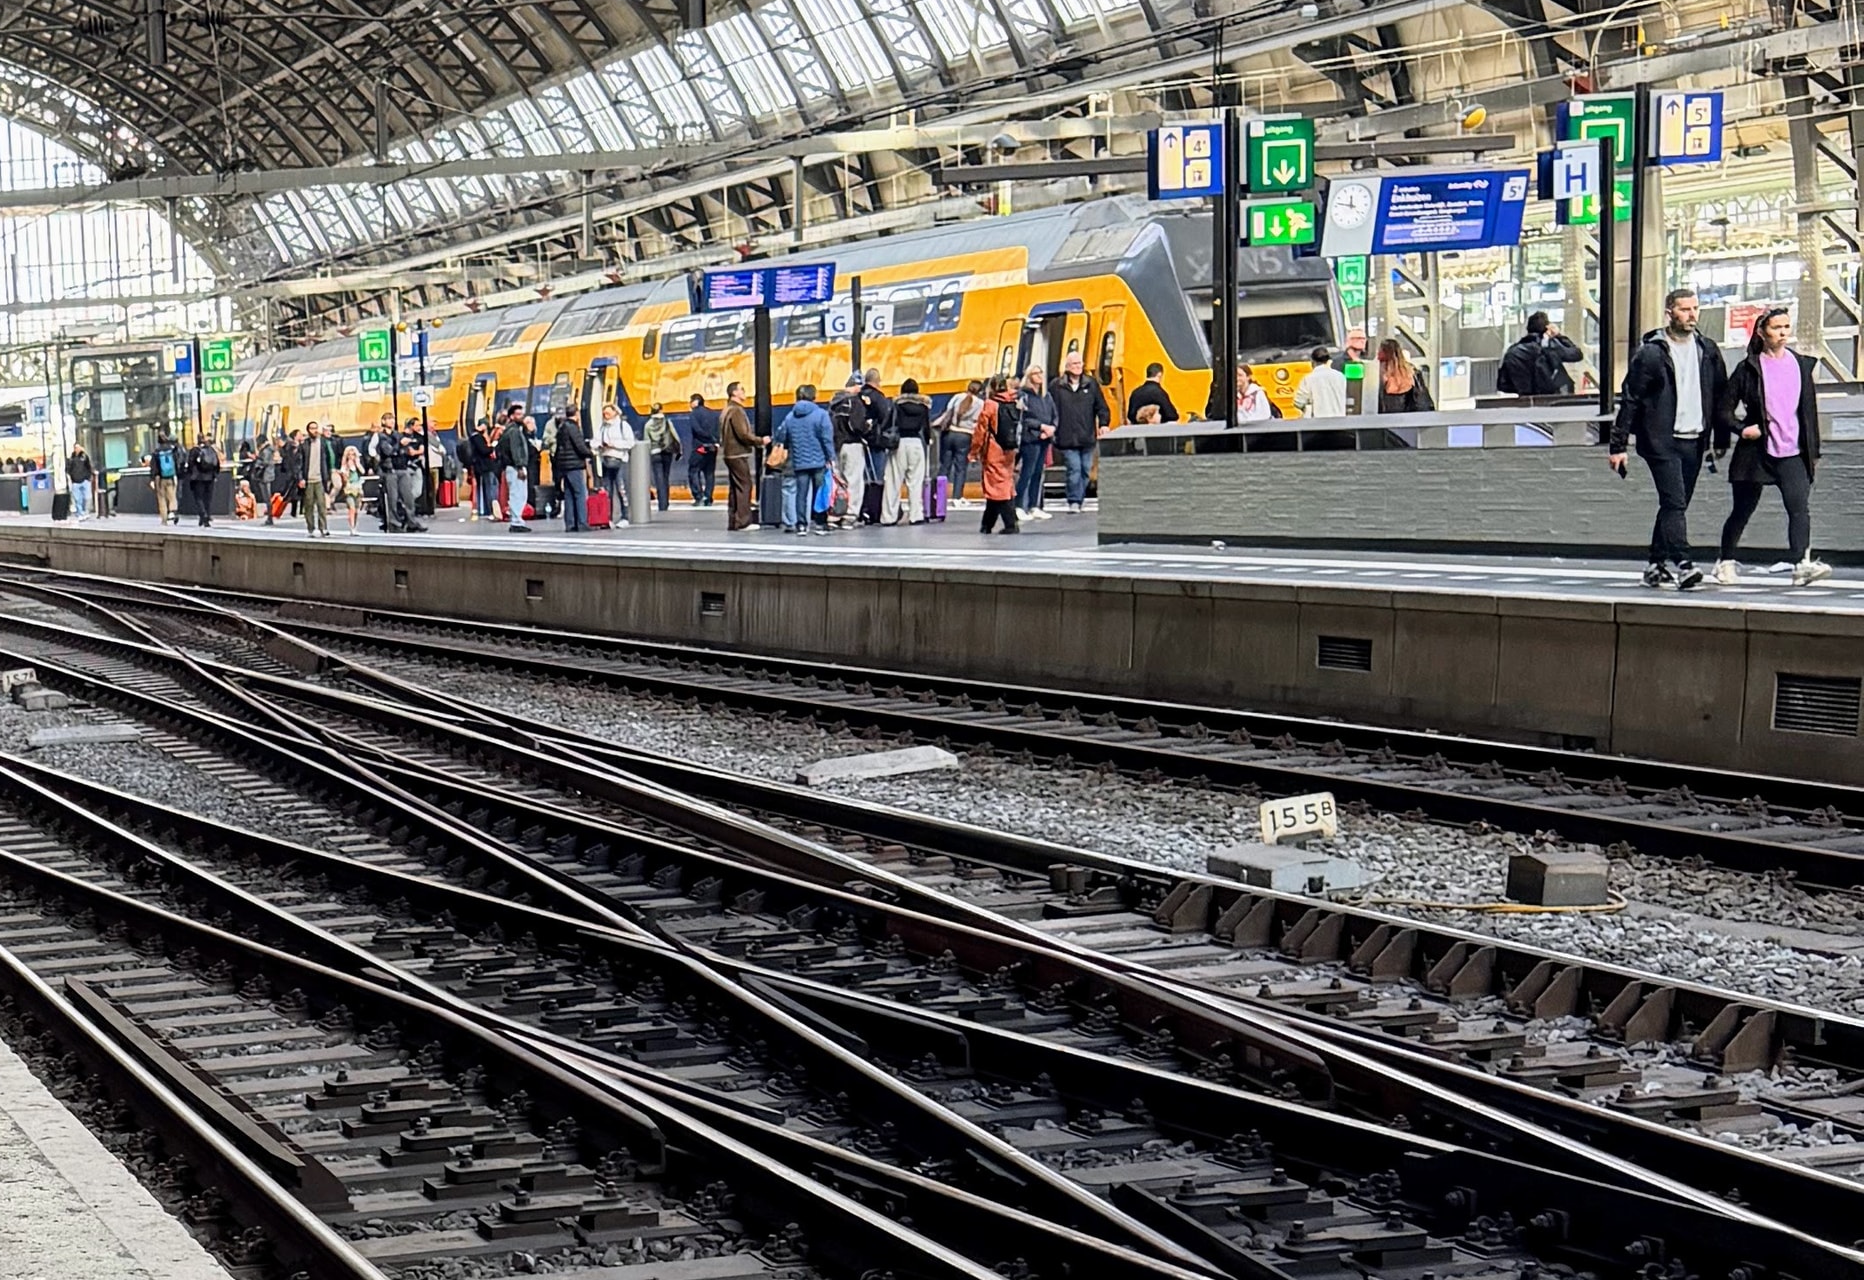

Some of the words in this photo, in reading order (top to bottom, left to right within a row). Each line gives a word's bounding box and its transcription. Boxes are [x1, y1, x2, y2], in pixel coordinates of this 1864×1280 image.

[1565, 161, 1587, 193] H
[832, 315, 846, 333] G
[872, 316, 885, 331] G
[1268, 800, 1334, 834] 155B
